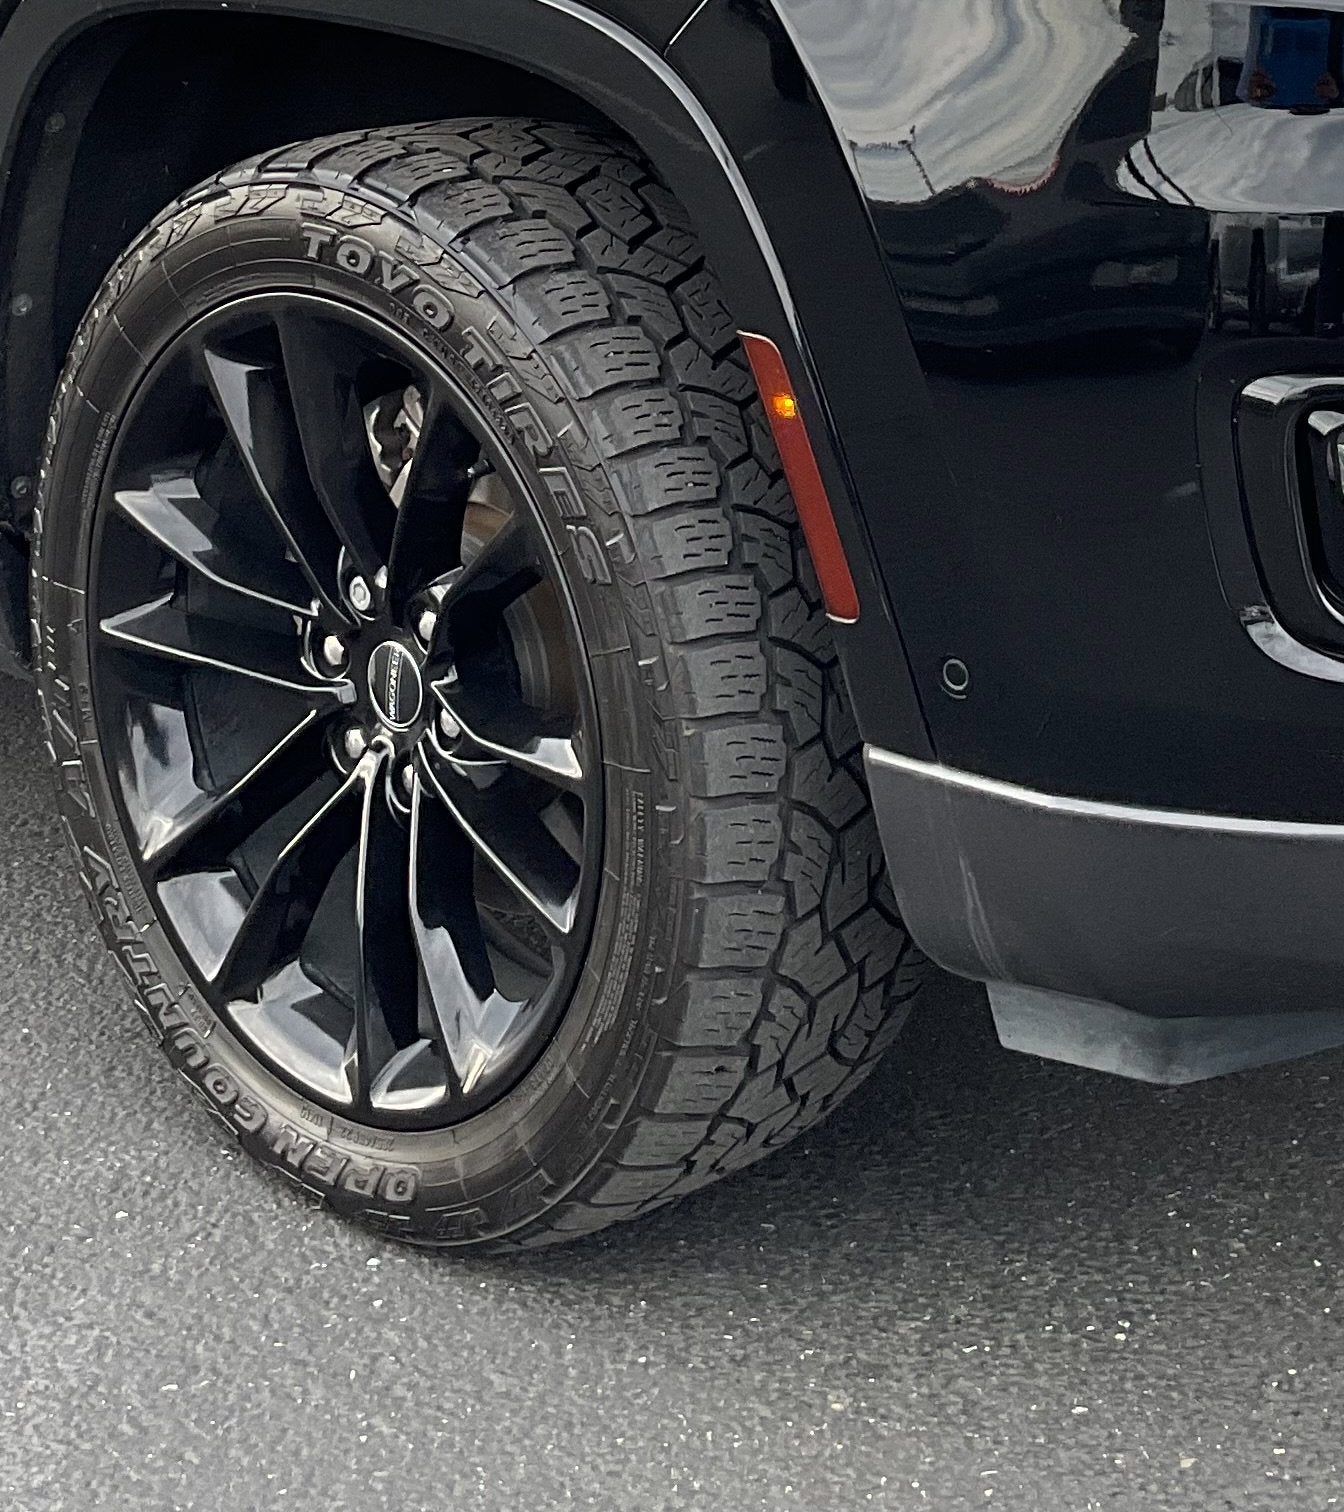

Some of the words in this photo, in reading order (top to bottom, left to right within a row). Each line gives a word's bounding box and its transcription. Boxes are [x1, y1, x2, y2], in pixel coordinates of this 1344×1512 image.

[299, 222, 457, 333] TOYO
[460, 325, 614, 586] TIRES
[82, 844, 269, 1134] COUNTRY
[271, 1122, 422, 1203] OPEN
